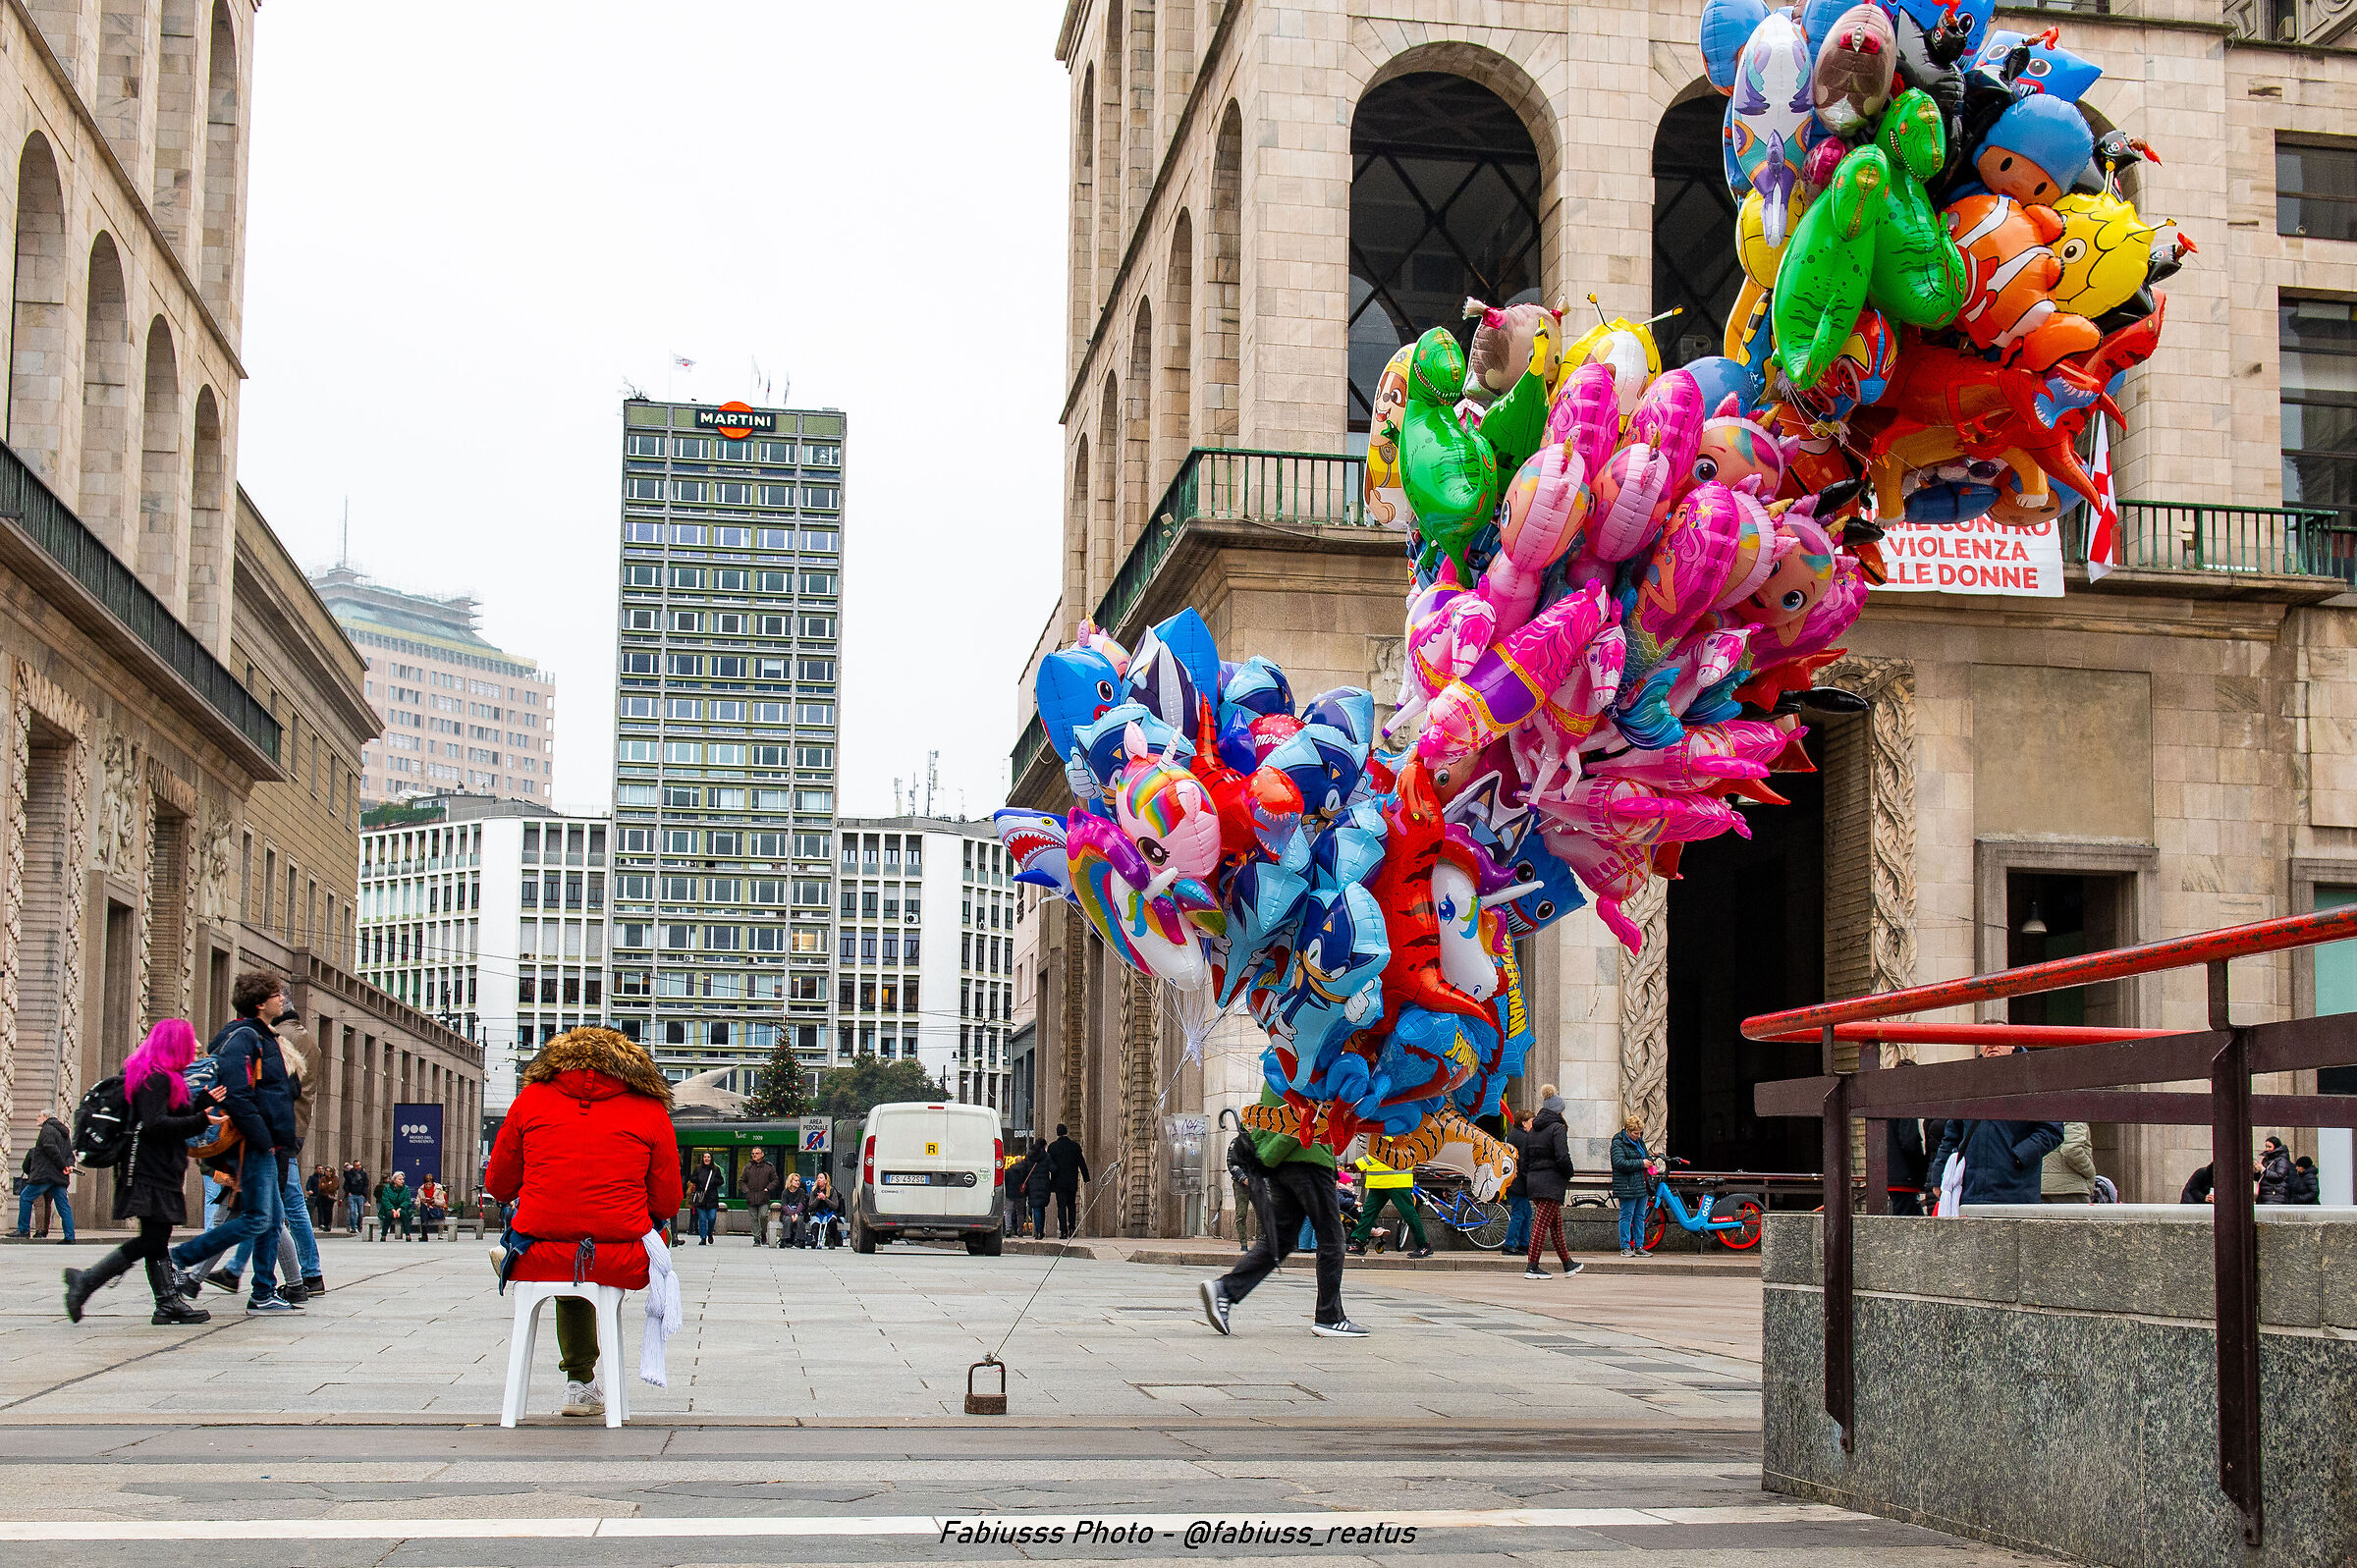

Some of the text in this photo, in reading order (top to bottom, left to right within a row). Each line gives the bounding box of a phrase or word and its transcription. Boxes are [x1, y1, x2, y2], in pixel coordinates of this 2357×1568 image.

[700, 412, 771, 427] MARTINI
[1887, 536, 2030, 562] VIOLENZA
[1886, 562, 2039, 589] LLE DONNE
[401, 1124, 428, 1137] 900
[927, 1145, 936, 1154] R
[1702, 1197, 1713, 1217] dott
